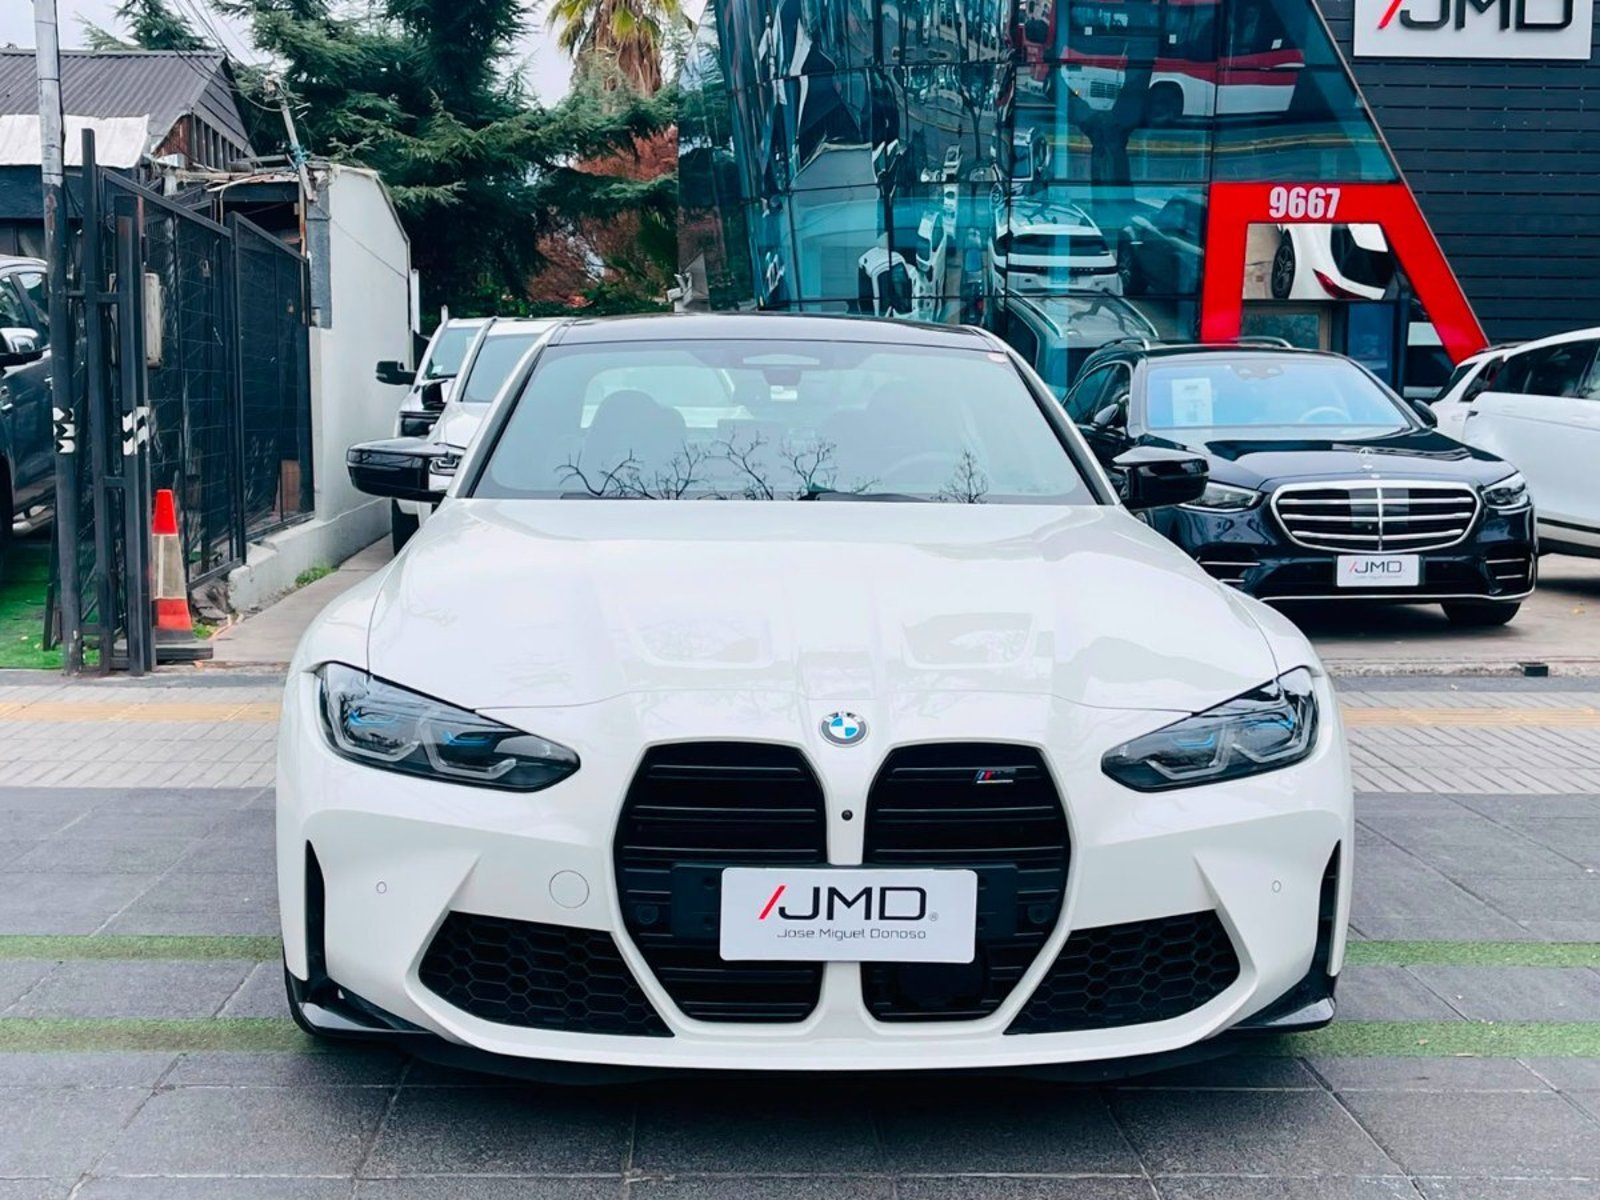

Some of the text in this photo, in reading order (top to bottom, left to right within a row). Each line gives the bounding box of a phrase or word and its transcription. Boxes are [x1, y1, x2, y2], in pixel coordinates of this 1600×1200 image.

[1269, 186, 1340, 219] 9667
[819, 928, 865, 941] Miguel
[870, 928, 926, 939] Donoso
